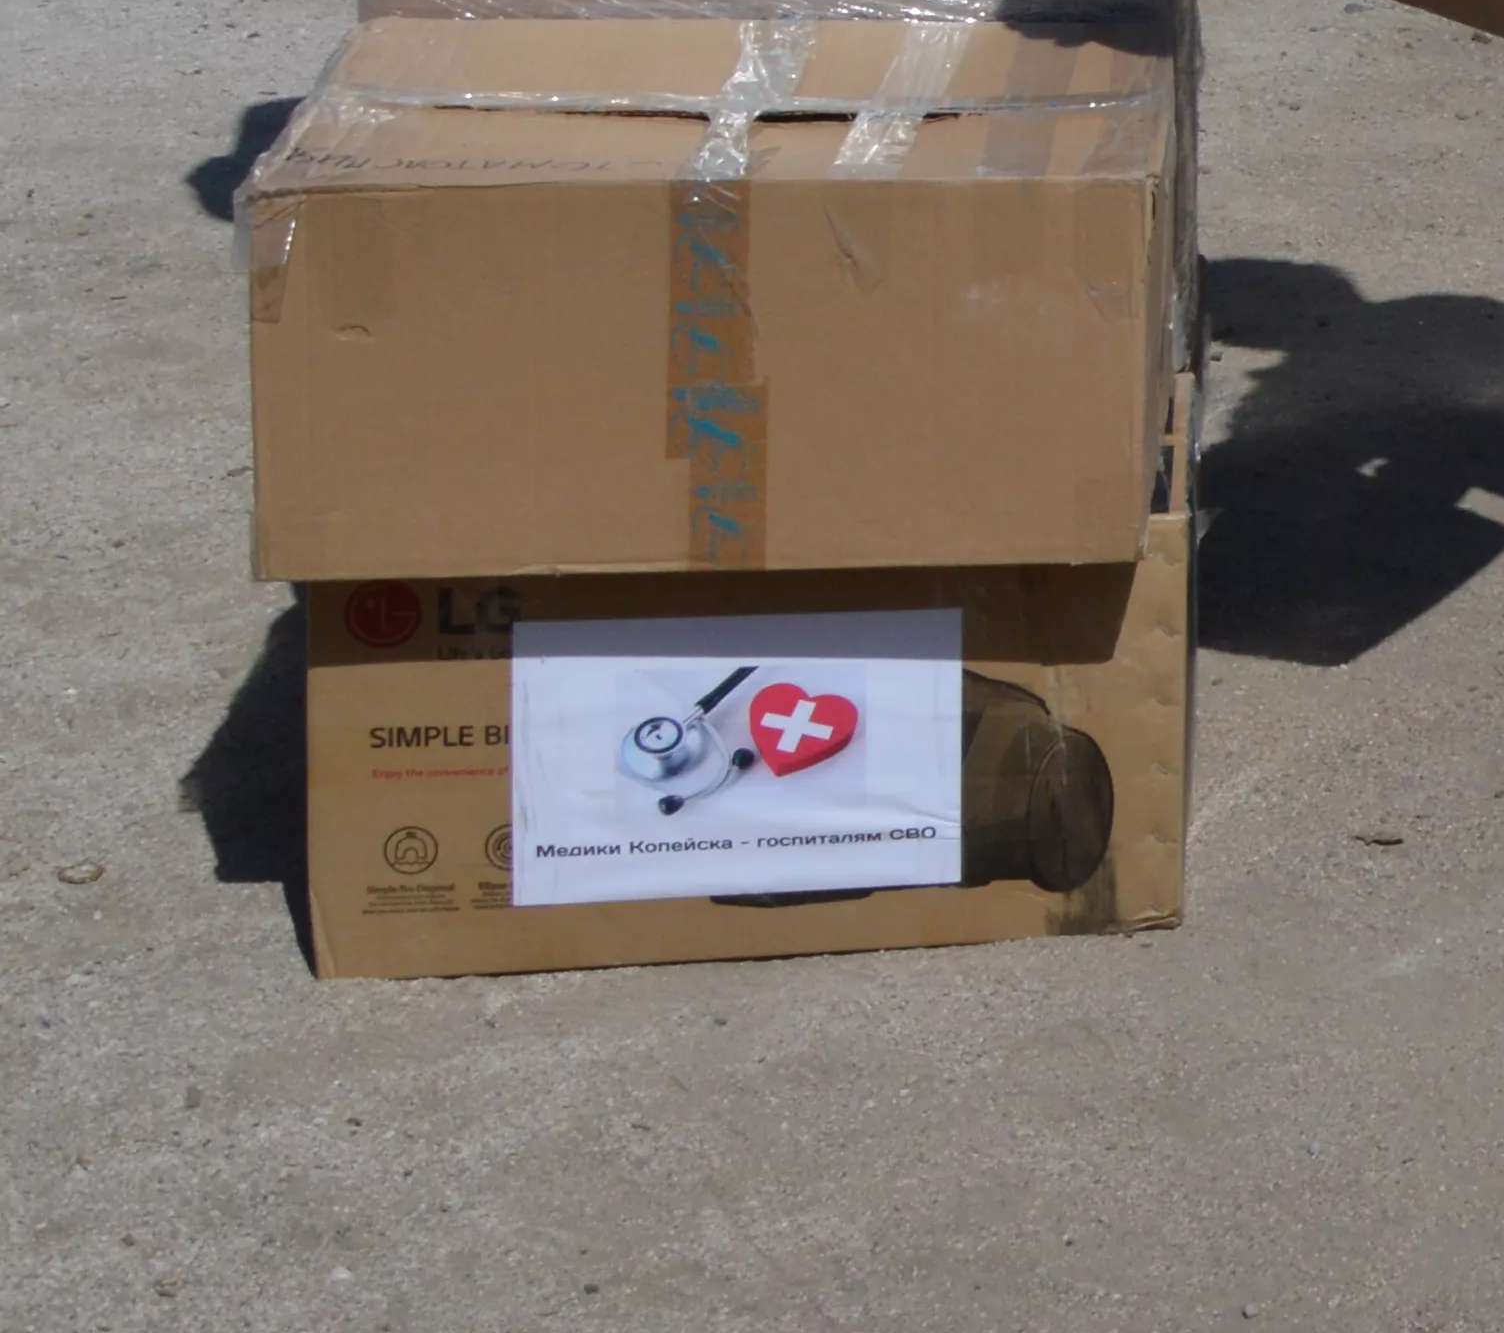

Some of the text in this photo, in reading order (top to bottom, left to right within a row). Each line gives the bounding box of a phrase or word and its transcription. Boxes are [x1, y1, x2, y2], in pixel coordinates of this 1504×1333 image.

[438, 586, 523, 635] LG
[369, 725, 475, 749] SIMPLE
[372, 767, 401, 780] Enjoy
[405, 768, 424, 778] the
[426, 766, 495, 778] convenience
[536, 843, 622, 858] Медики
[629, 835, 733, 855] Копейска
[756, 830, 882, 849] госпиталям
[889, 825, 938, 841] СВО
